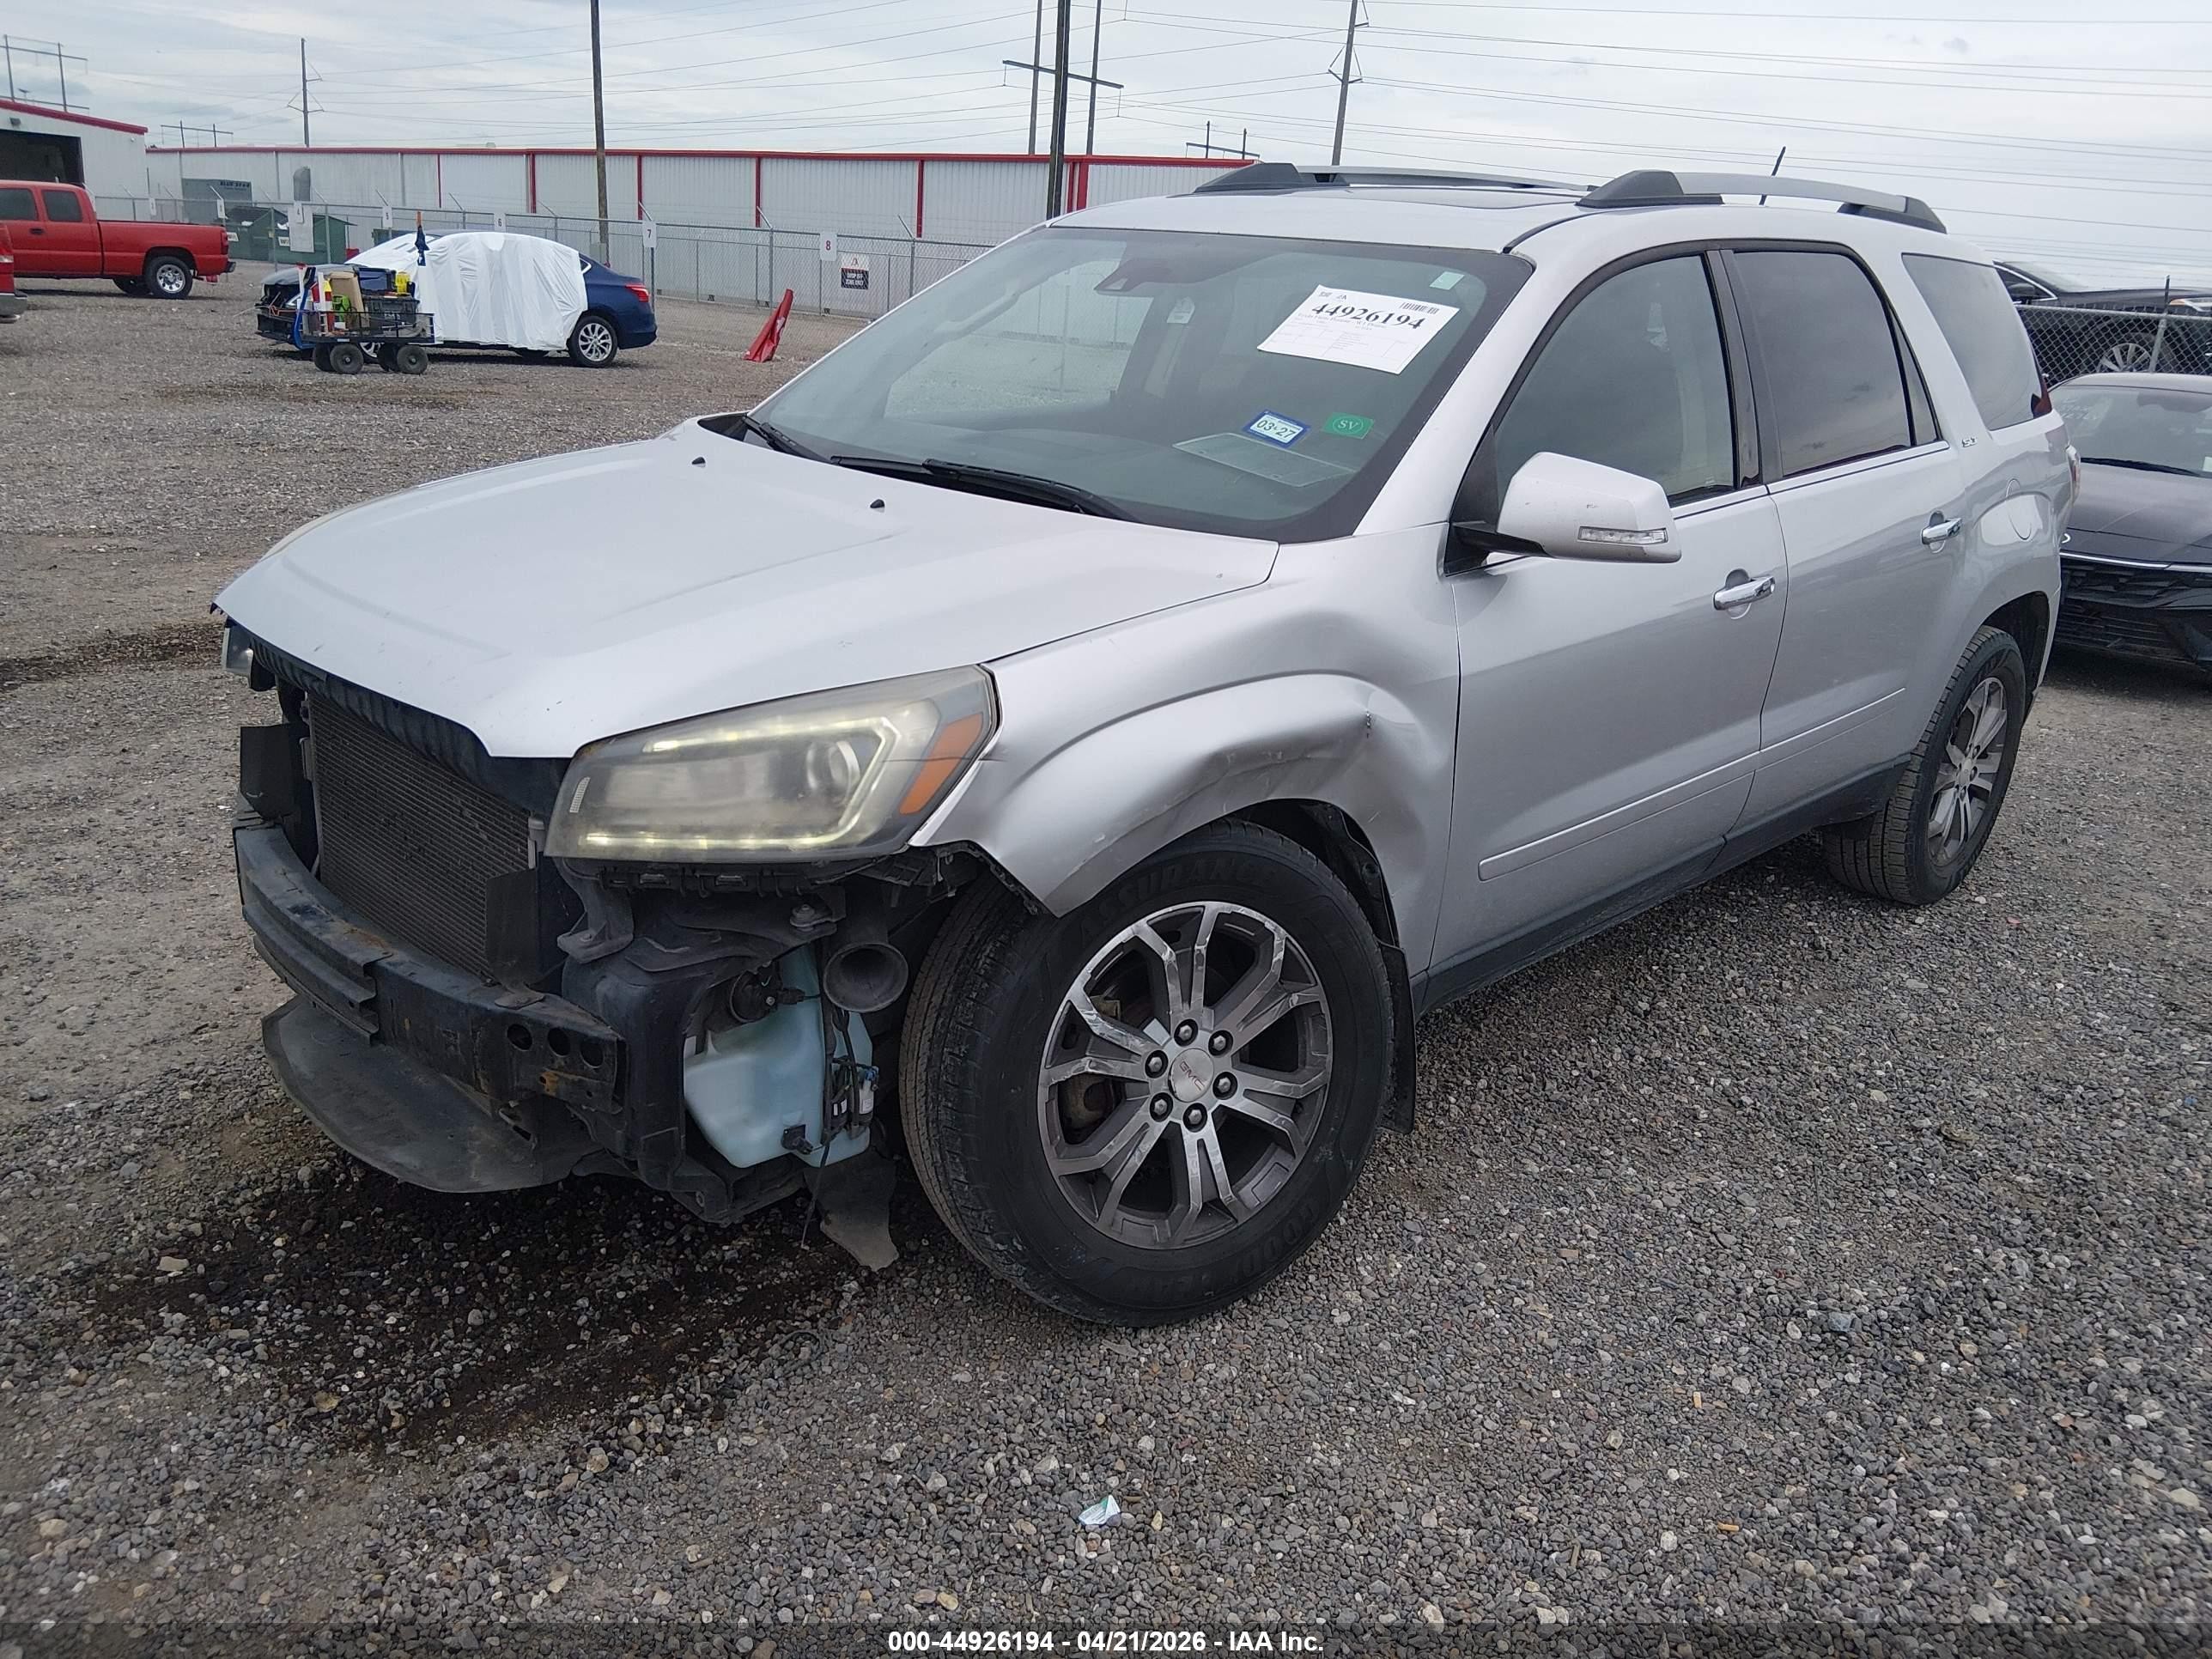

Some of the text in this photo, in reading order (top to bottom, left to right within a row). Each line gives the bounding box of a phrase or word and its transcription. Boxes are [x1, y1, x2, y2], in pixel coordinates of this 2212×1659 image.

[647, 228, 652, 238] 7
[826, 240, 831, 251] 8
[1312, 303, 1425, 330] 44926194
[1338, 419, 1359, 430] SV
[1180, 1061, 1205, 1091] GMC
